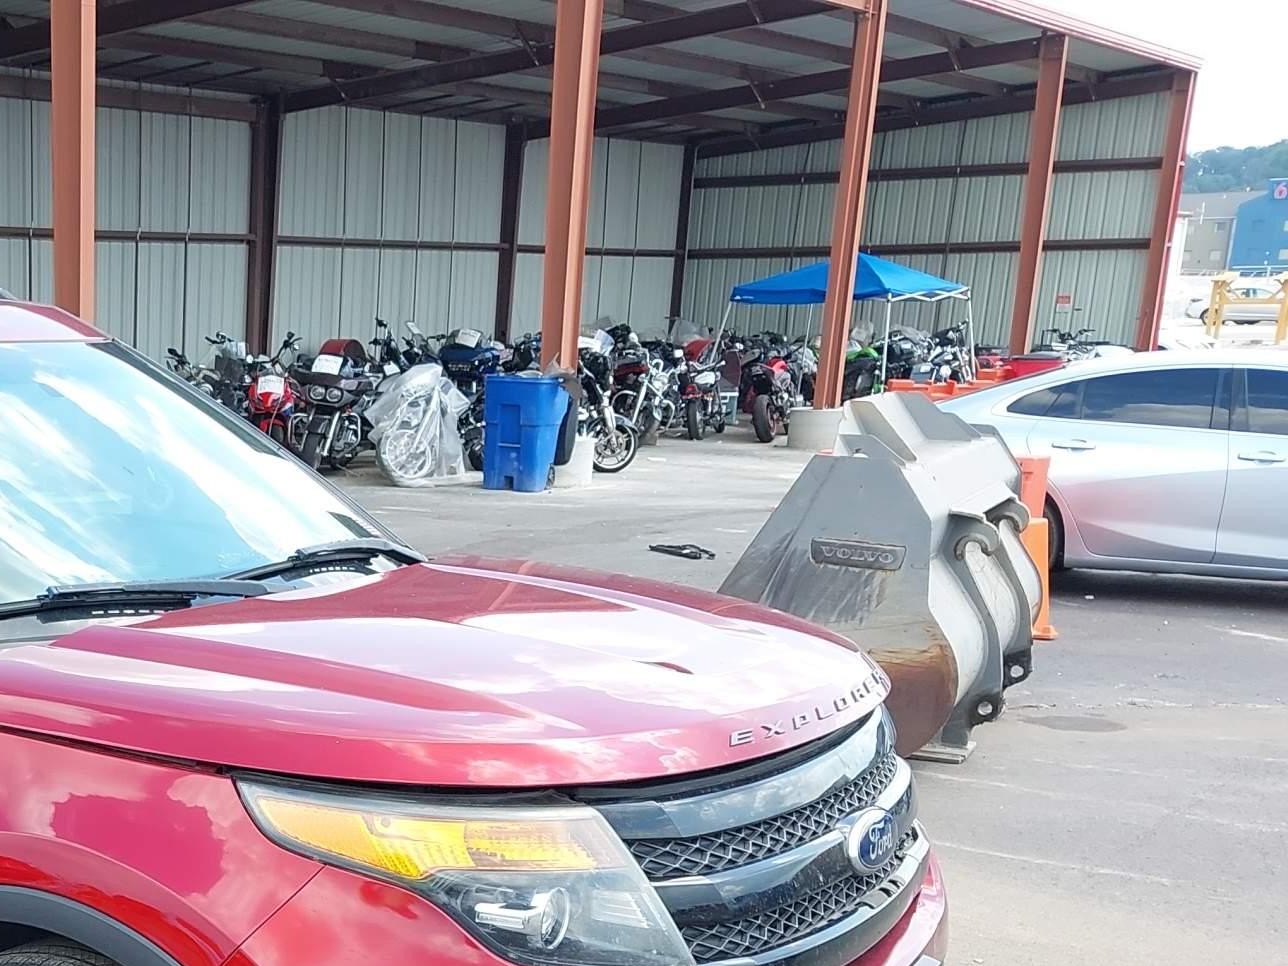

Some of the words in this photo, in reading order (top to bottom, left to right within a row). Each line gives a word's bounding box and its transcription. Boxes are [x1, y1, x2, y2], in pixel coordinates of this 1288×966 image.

[820, 545, 894, 564] VOLVO
[728, 670, 884, 748] EXPLORER
[868, 819, 893, 861] Ford
